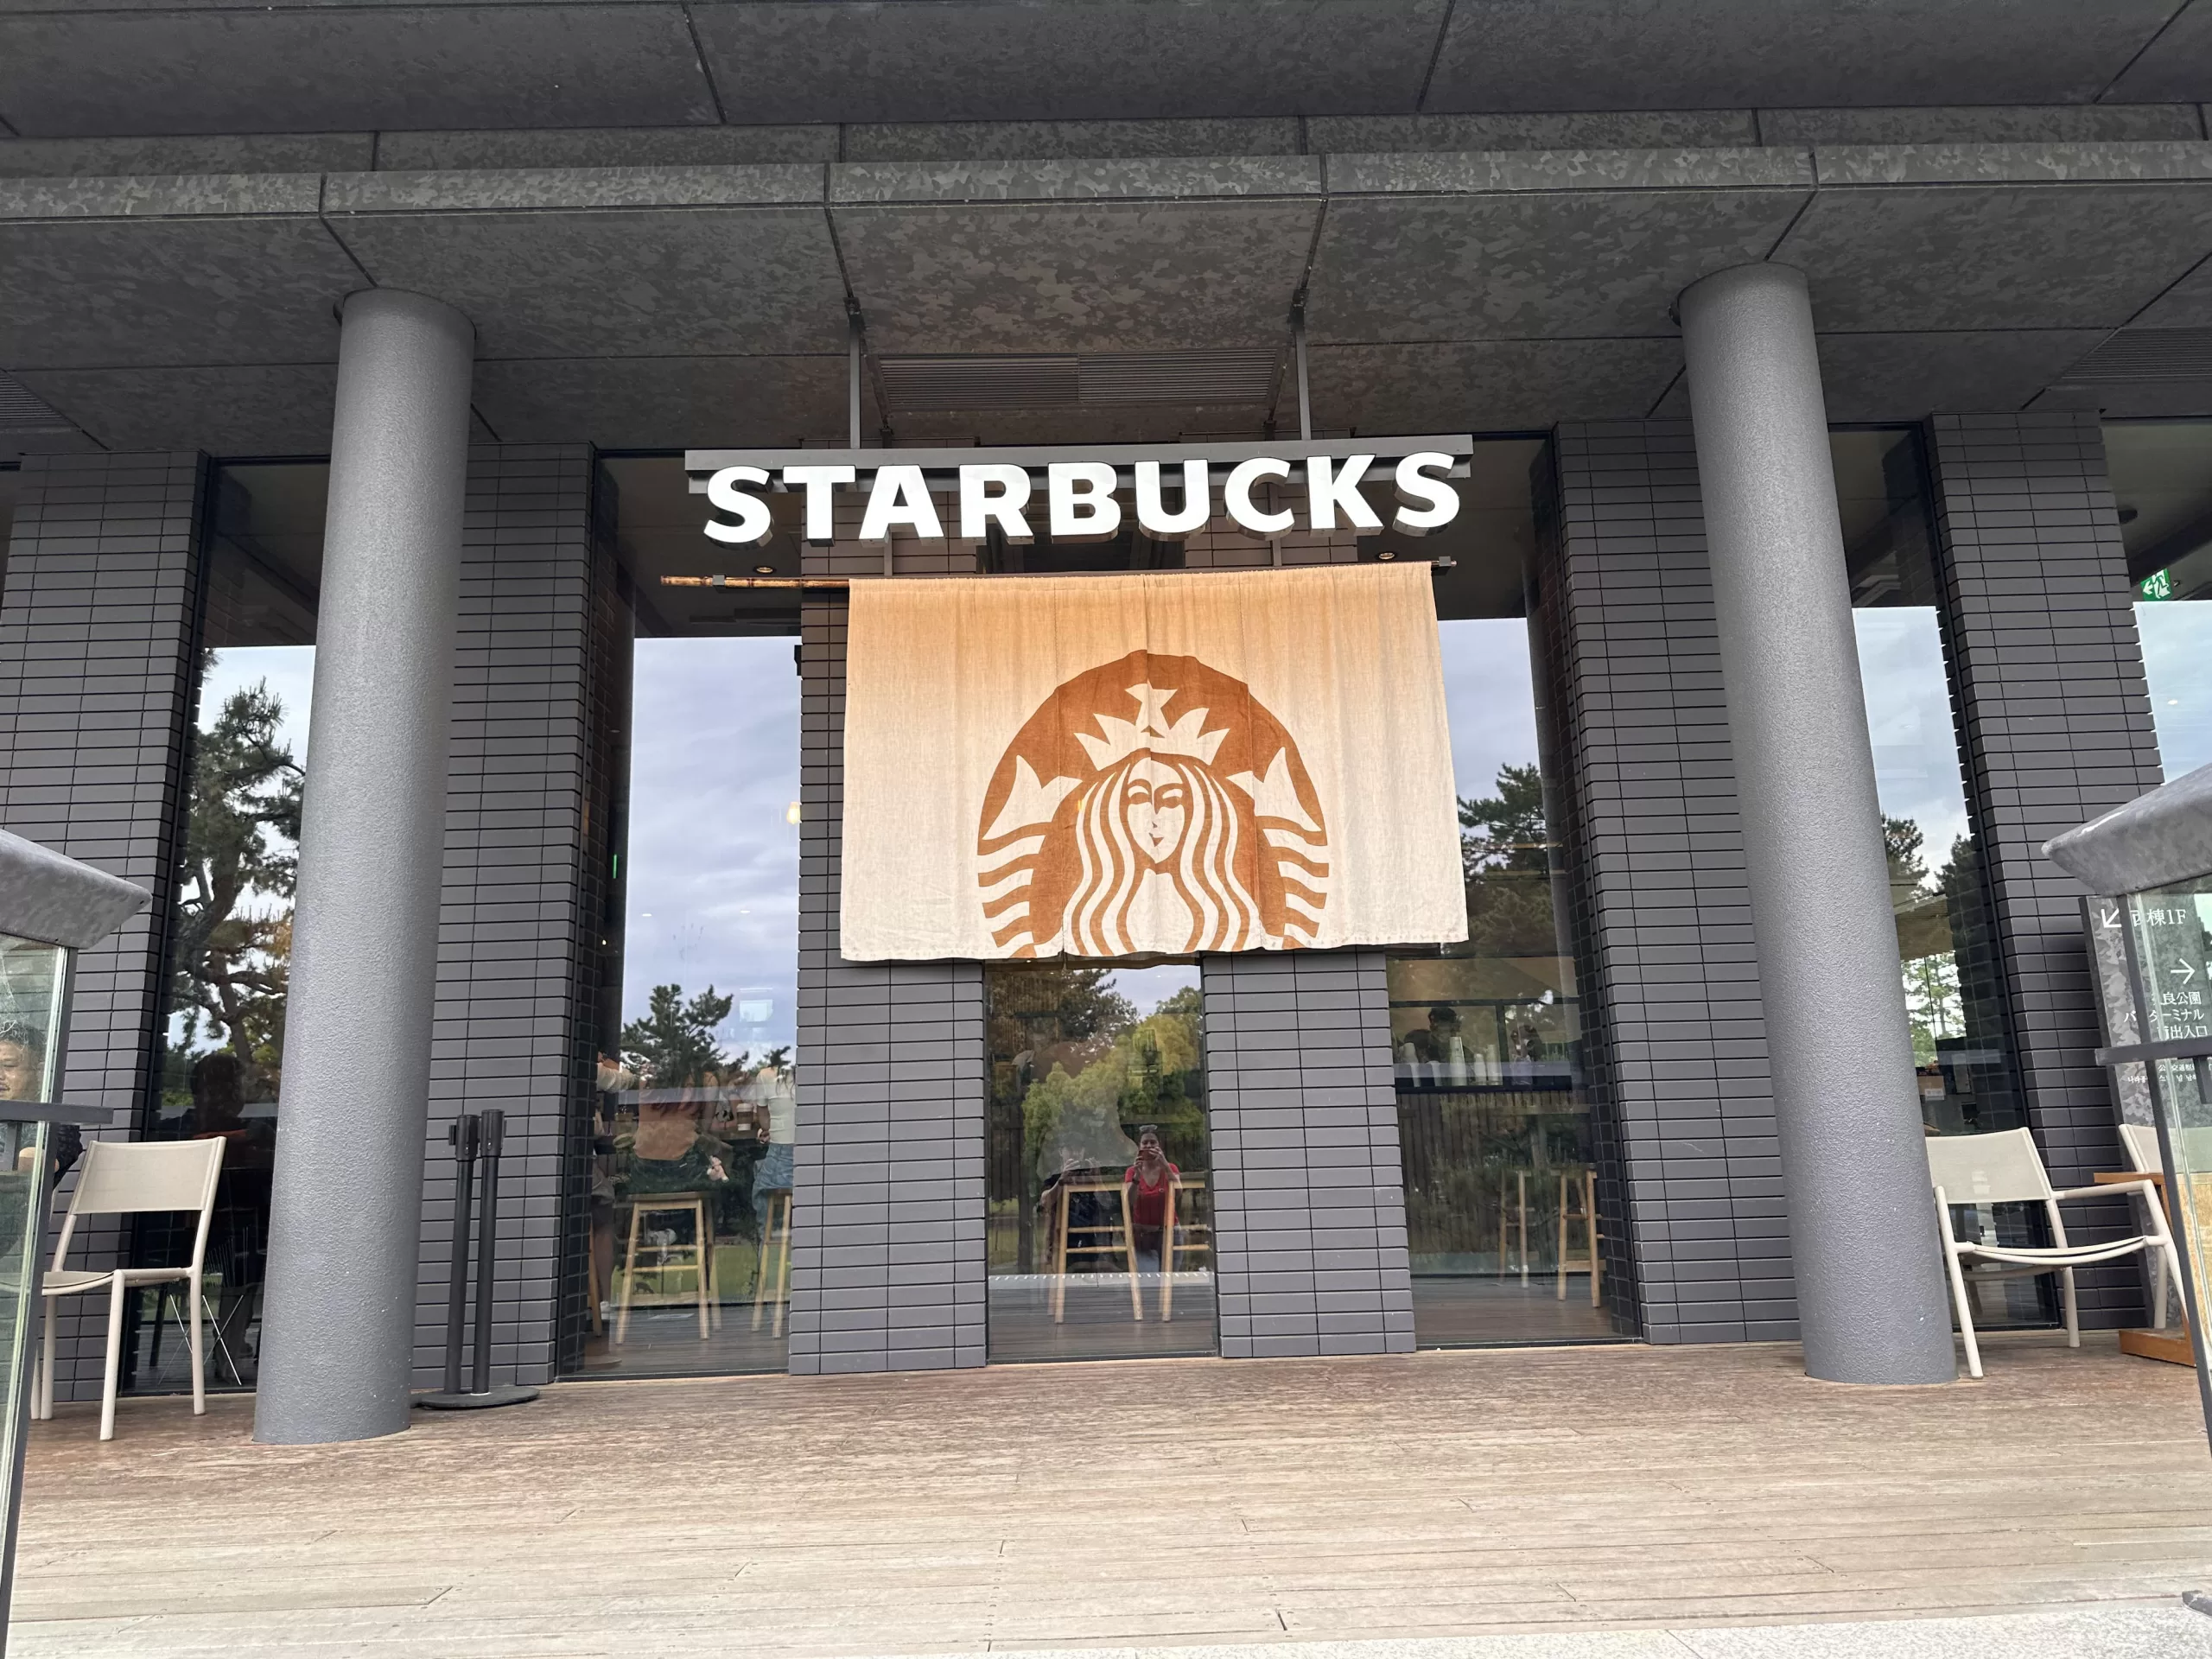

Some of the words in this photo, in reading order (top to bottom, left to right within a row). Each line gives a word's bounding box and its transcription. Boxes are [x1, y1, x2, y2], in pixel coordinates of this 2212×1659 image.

[703, 451, 1461, 545] STARBUCKS
[2123, 1008, 2205, 1023] バターミナル
